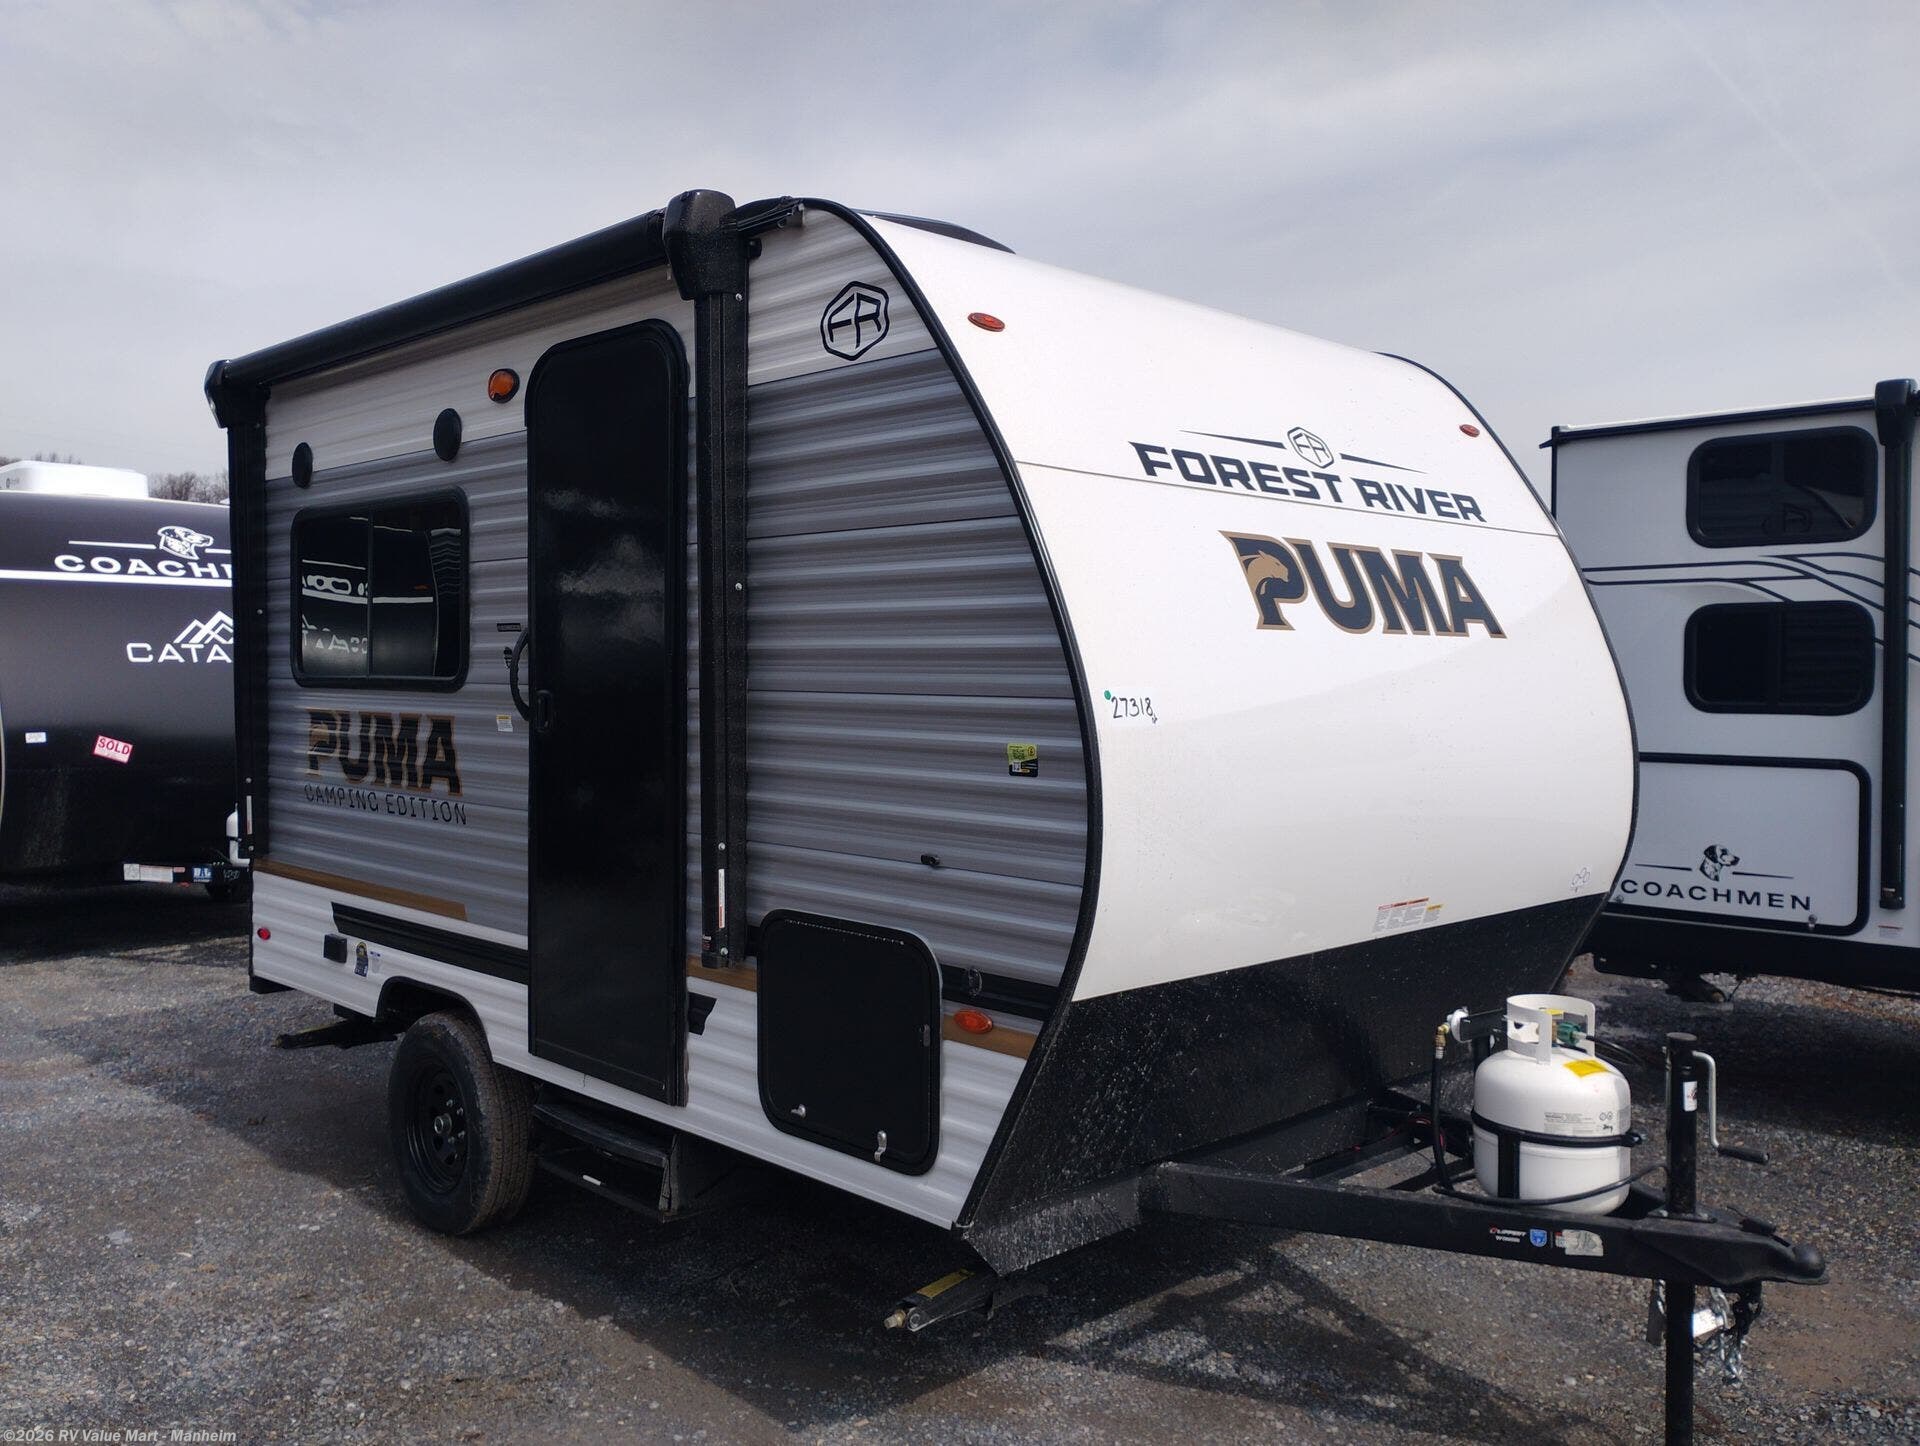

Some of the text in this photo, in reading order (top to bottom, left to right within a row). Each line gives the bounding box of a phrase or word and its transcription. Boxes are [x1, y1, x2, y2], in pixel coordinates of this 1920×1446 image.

[1128, 441, 1487, 523] FOREST RIVER
[1218, 530, 1507, 639] PUMA
[1111, 696, 1154, 719] 27318
[97, 738, 130, 756] SOLD
[303, 708, 463, 797] PUMA
[304, 784, 467, 826] CAMPING EDITION
[1620, 879, 1812, 911] COACHMEN
